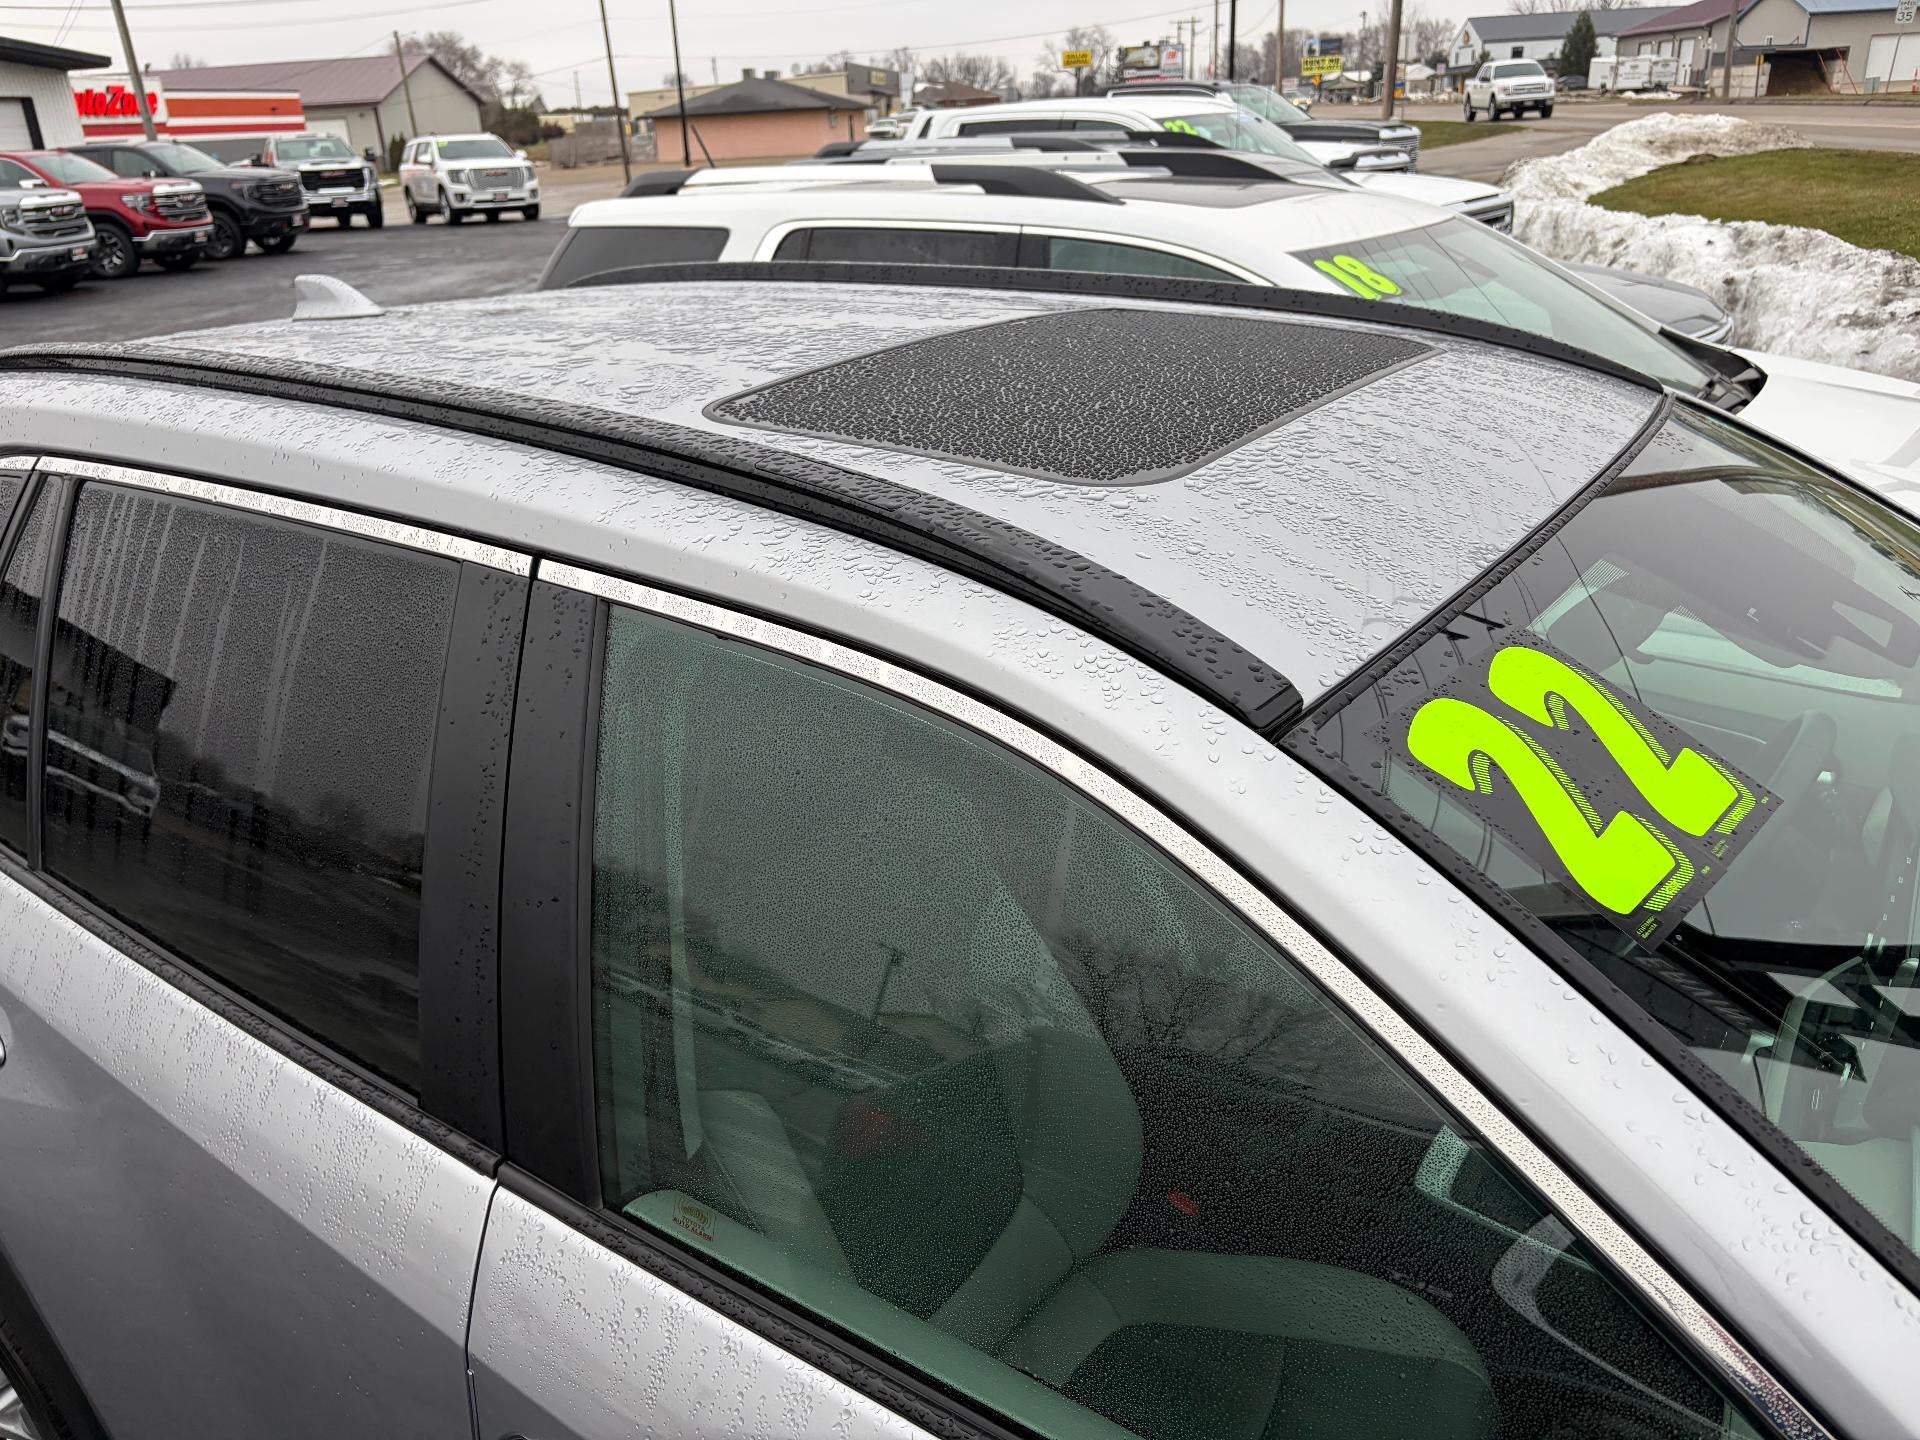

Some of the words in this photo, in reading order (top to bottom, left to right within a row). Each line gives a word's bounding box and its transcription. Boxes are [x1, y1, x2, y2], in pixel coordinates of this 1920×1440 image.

[1897, 11, 1913, 22] 35
[1313, 254, 1402, 301] 18
[1407, 646, 1752, 915] 22
[673, 1216, 689, 1229] AUTO
